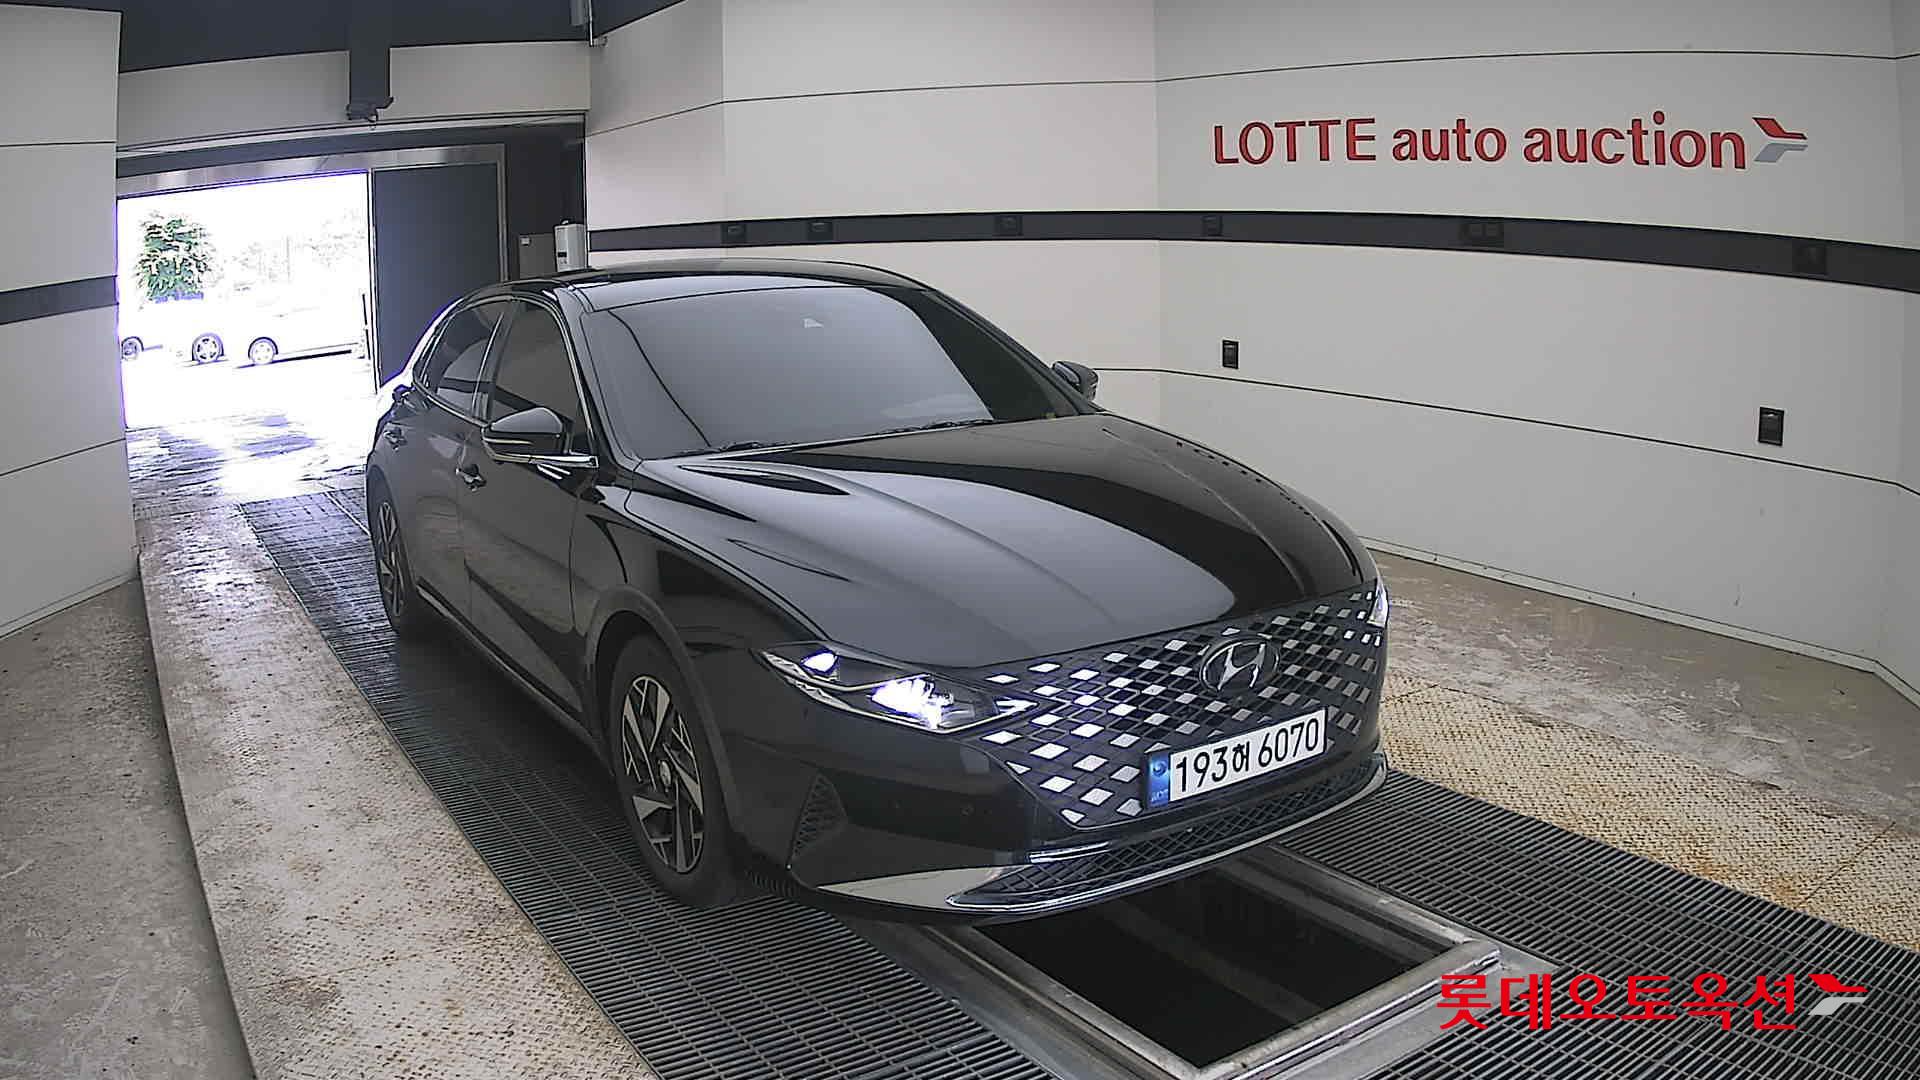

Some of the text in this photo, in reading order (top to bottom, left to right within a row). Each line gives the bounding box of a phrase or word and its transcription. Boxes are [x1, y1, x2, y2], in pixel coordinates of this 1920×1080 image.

[1213, 111, 1747, 169] LOTTE auto auction
[1258, 718, 1319, 768] 6070
